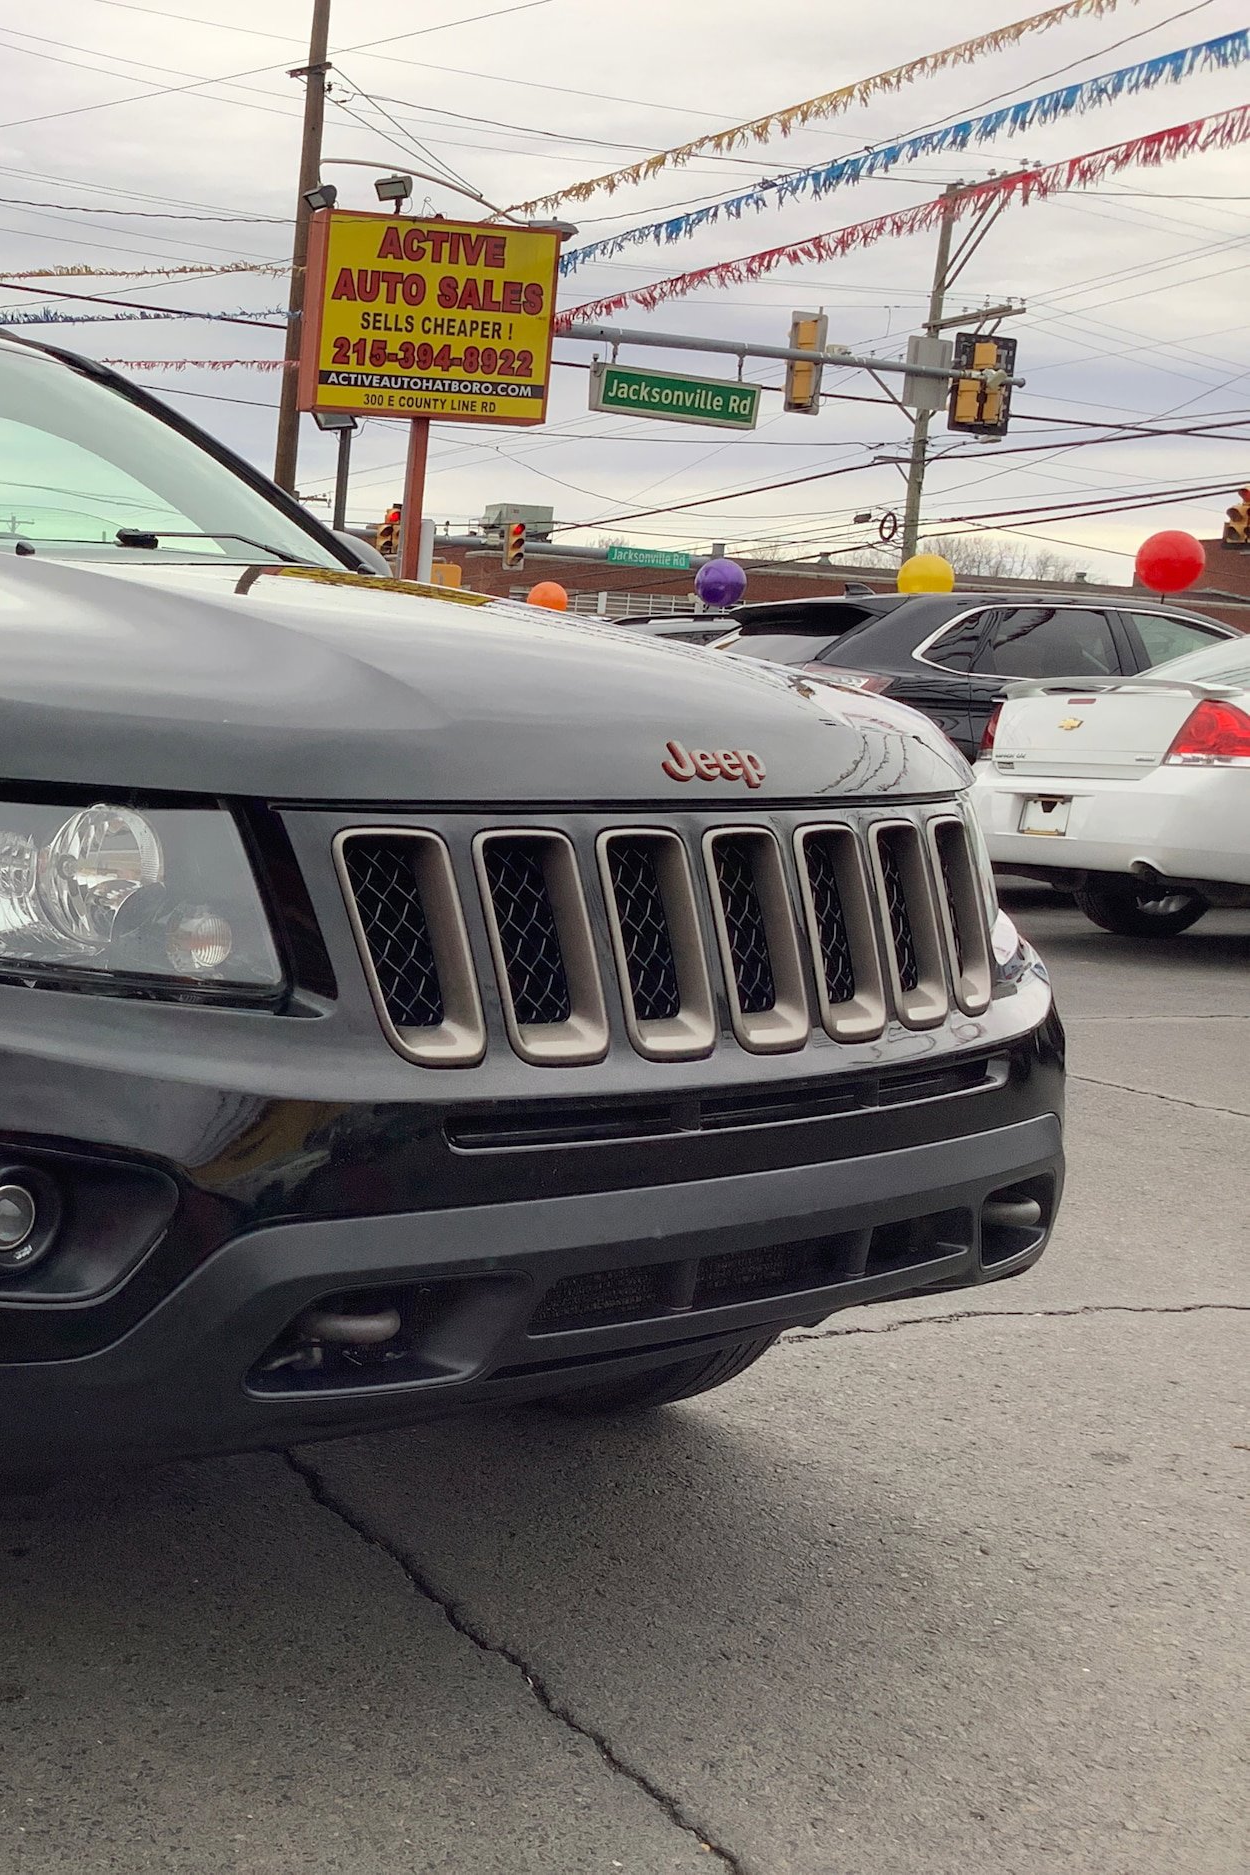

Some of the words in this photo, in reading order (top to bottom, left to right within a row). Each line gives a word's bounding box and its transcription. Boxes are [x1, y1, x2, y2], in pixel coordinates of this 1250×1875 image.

[377, 226, 507, 269] ACTIVE
[331, 267, 427, 307] AUTO
[436, 275, 544, 316] SALES
[360, 311, 414, 333] SELLS
[421, 316, 503, 340] CHEAPER
[331, 336, 534, 378] 215-394-8922
[327, 372, 533, 397] ACTIVEAUTOHATBORO.COM
[363, 393, 384, 406] 300
[387, 395, 395, 407] E
[398, 396, 447, 411] COUNTY
[450, 398, 478, 412] LINE
[481, 401, 497, 413] RD
[607, 378, 723, 411] Jacksonville
[727, 394, 752, 415] Rd
[612, 548, 671, 565] Jacksonville
[672, 553, 686, 567] Rd
[661, 740, 767, 789] Jeep
